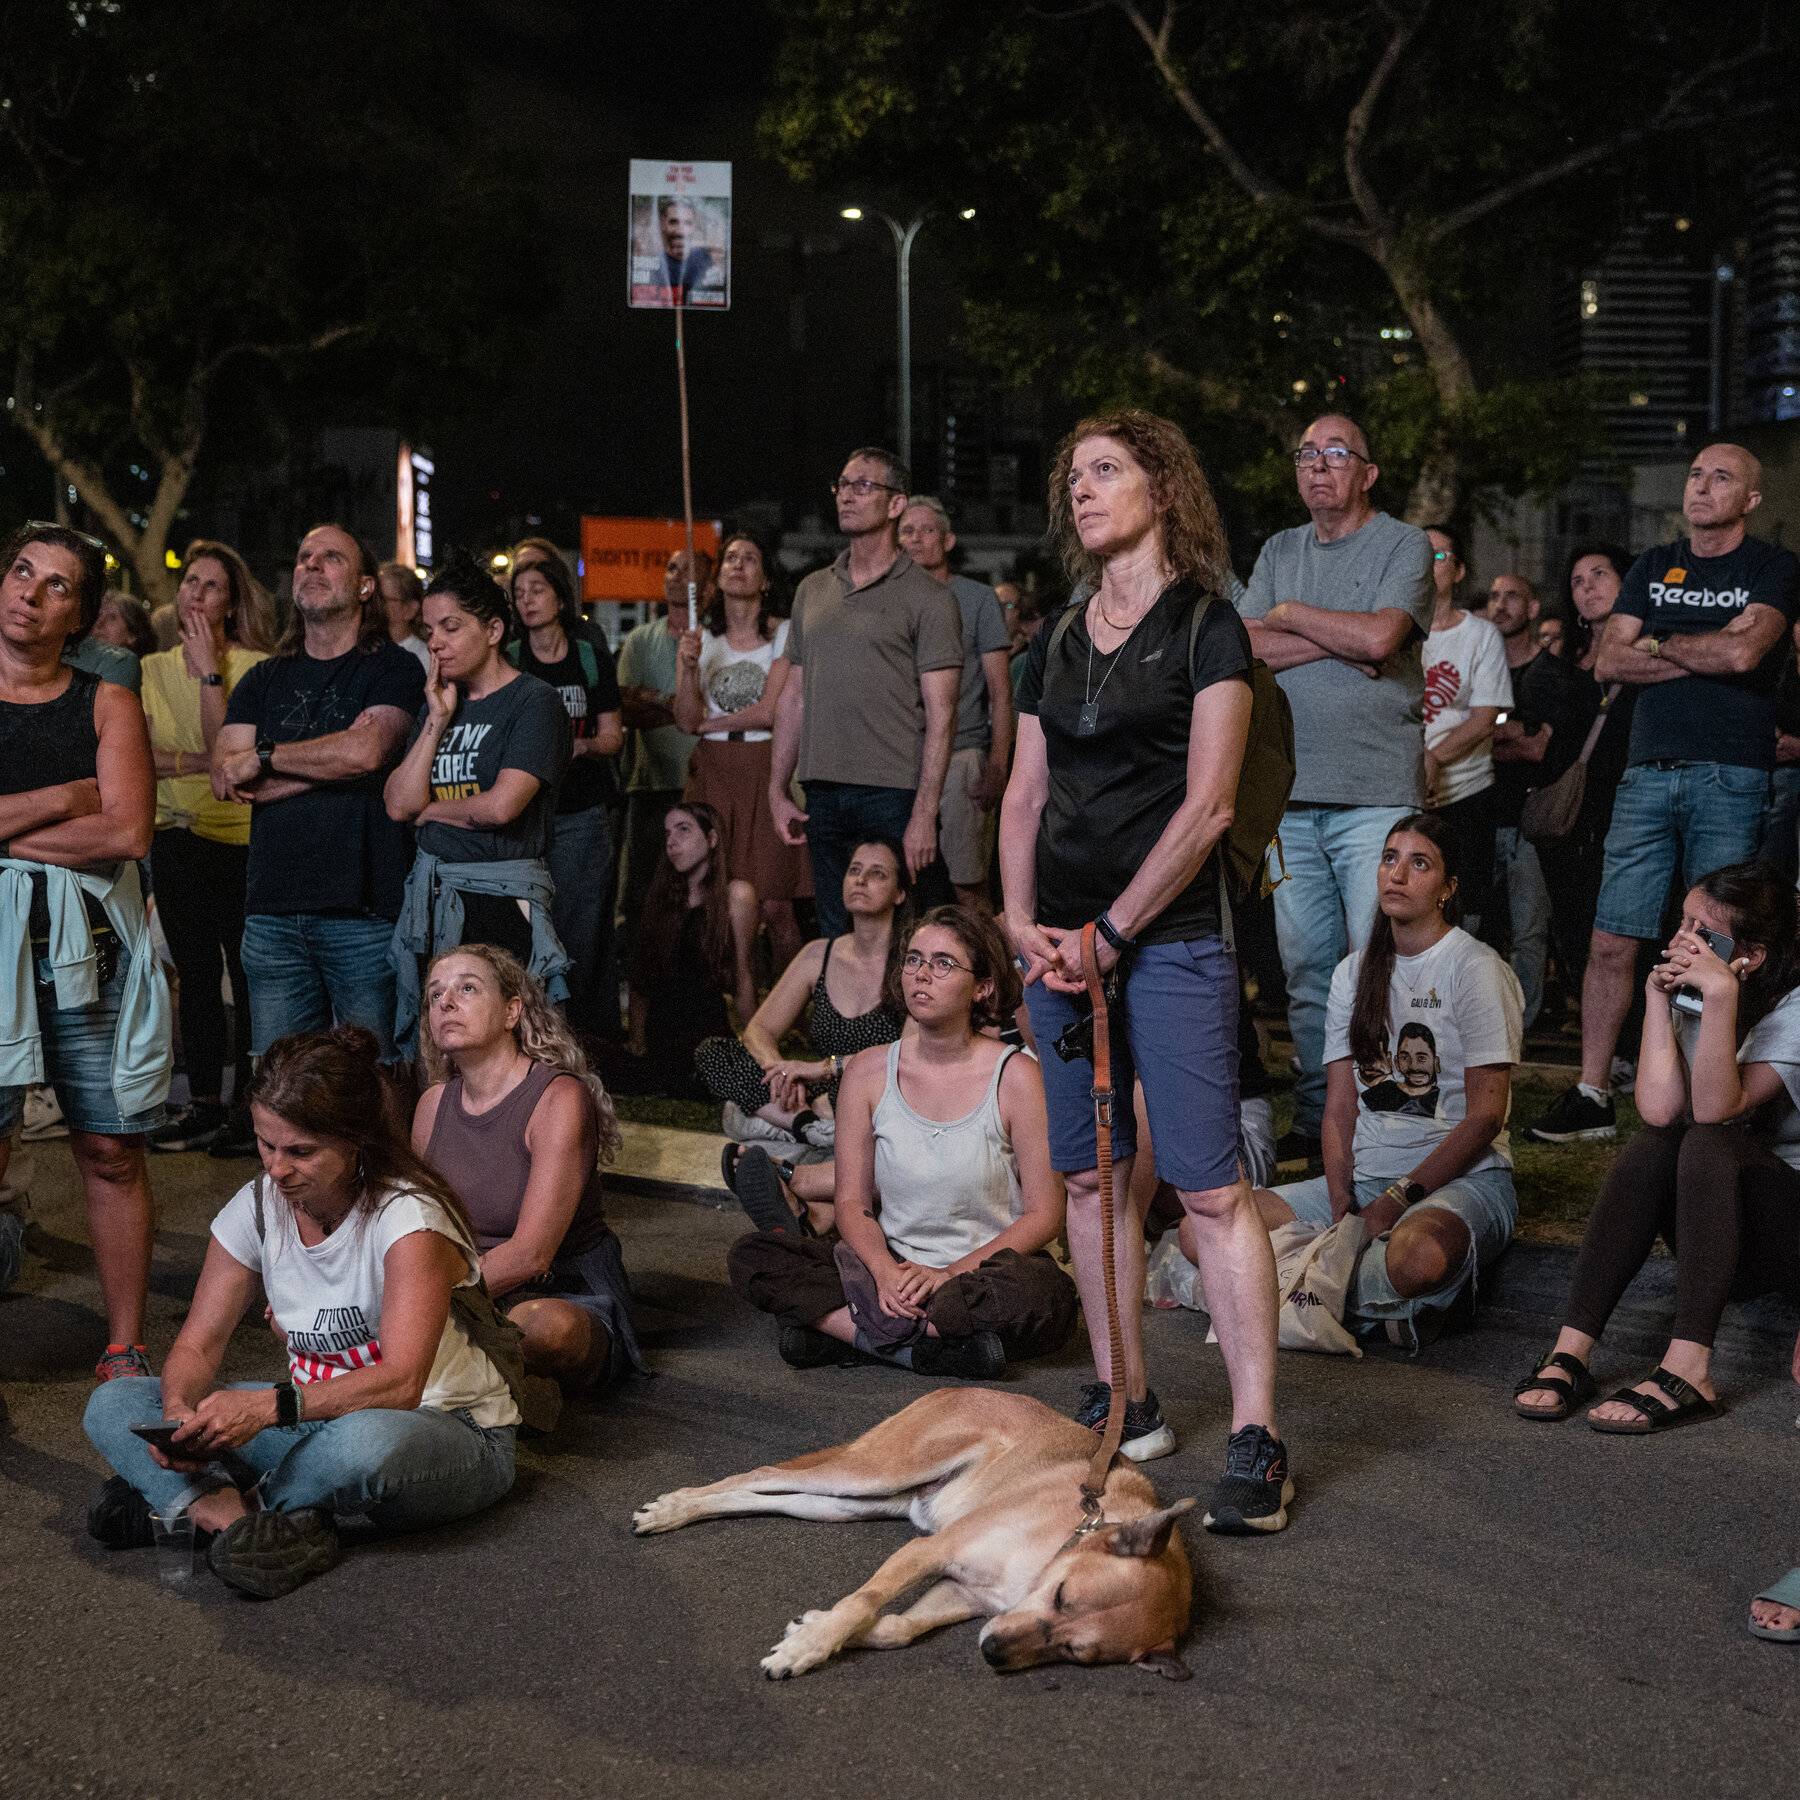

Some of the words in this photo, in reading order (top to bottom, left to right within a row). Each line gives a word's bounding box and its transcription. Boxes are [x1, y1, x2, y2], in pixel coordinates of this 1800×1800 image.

[1648, 582, 1750, 608] Reebok
[459, 723, 493, 752] MY
[1411, 998, 1423, 1008] GALI
[1429, 999, 1442, 1009] ZIVI
[313, 1306, 366, 1331] מחזירים
[330, 1325, 376, 1352] אותם
